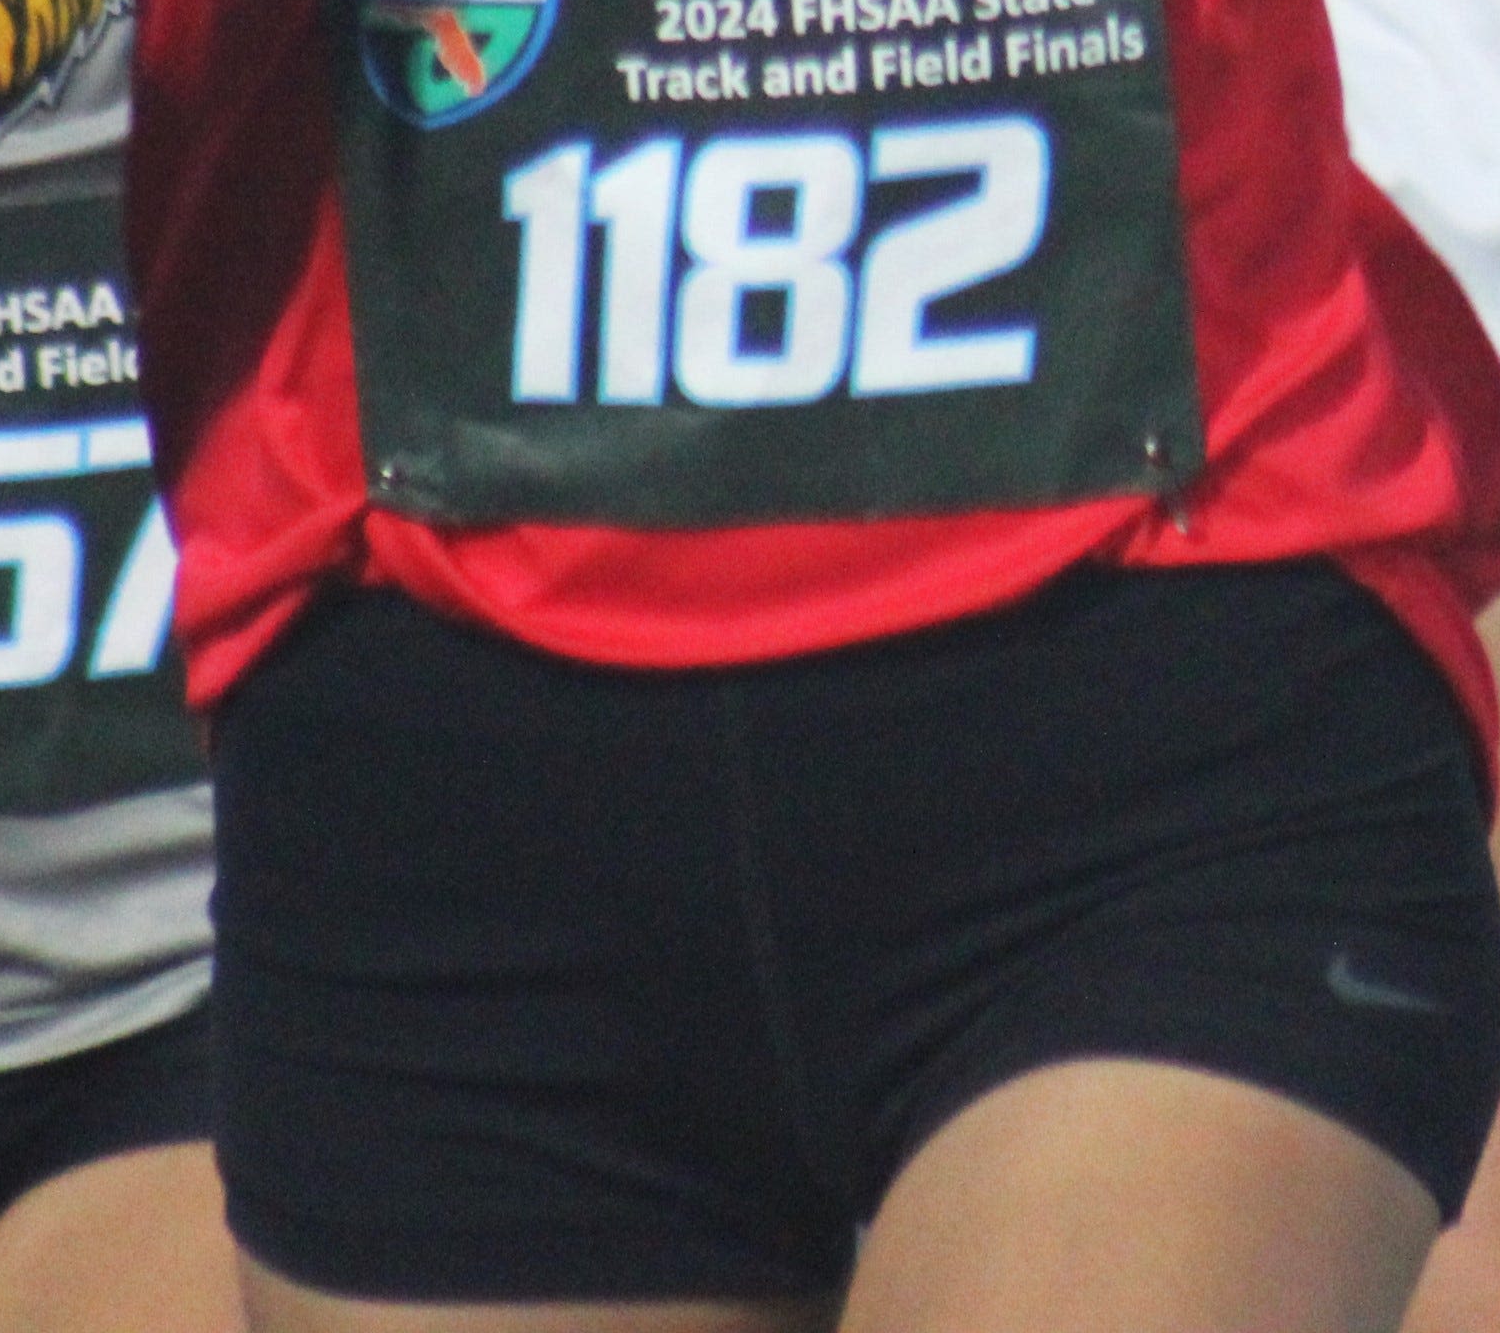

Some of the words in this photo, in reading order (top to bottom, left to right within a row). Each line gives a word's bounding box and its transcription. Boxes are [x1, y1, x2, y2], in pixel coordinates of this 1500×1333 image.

[616, 51, 749, 102] Track
[762, 44, 857, 97] and
[871, 34, 992, 91] Field
[1005, 13, 1146, 78] Finals
[503, 114, 1050, 407] 1182
